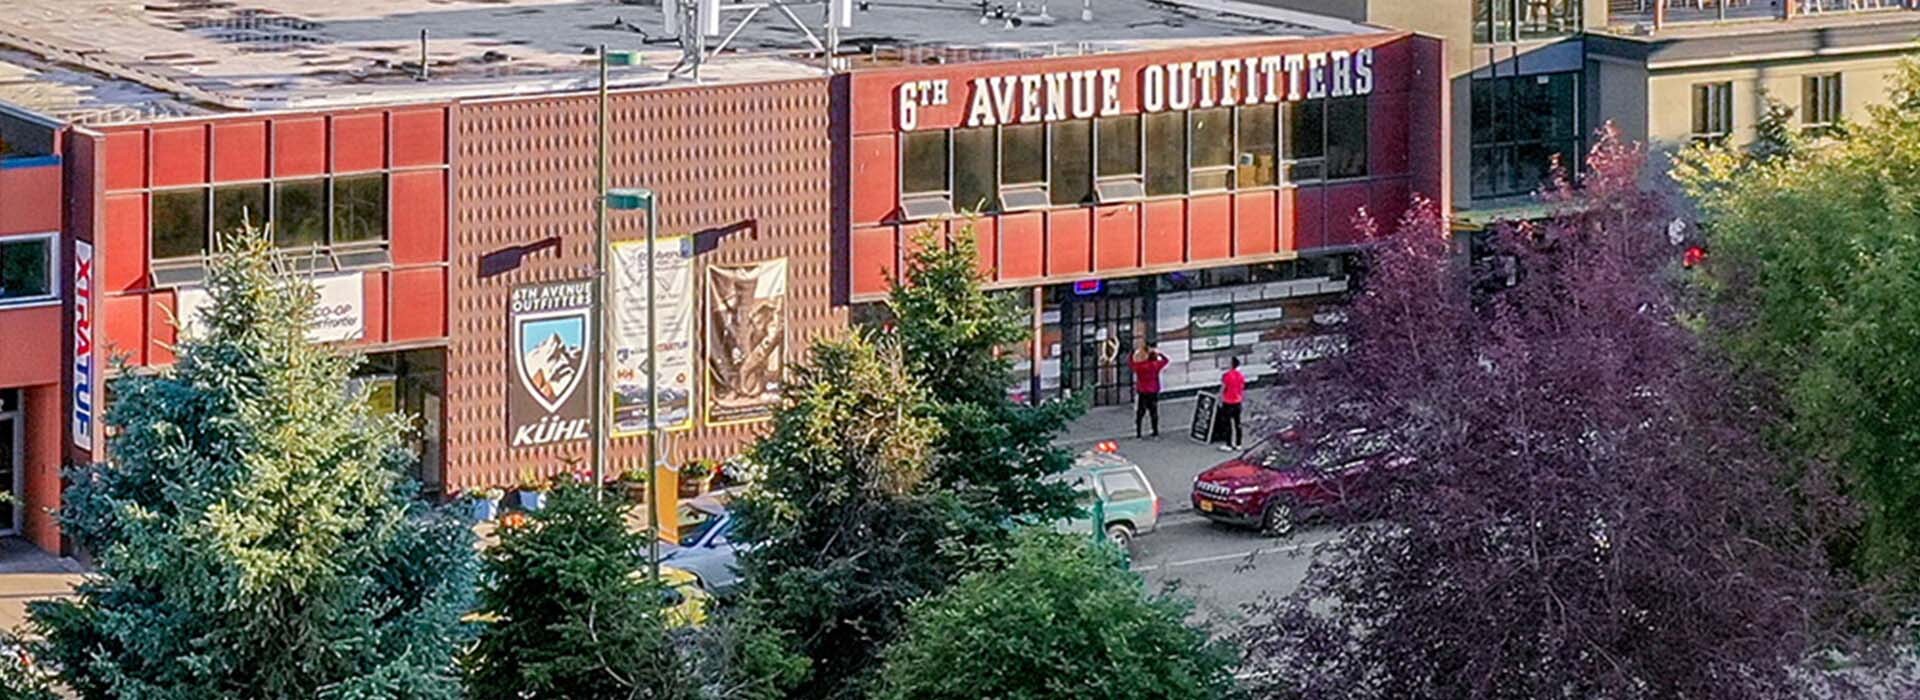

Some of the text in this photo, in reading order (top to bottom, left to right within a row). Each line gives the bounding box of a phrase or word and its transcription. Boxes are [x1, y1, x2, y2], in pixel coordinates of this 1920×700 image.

[900, 47, 1374, 131] 6TH AVENUE OUTFITTERS
[512, 294, 593, 312] OUTFITTERS
[540, 281, 593, 298] AVENUE
[76, 257, 92, 434] XTRATUF
[512, 415, 591, 446] KÜHL
